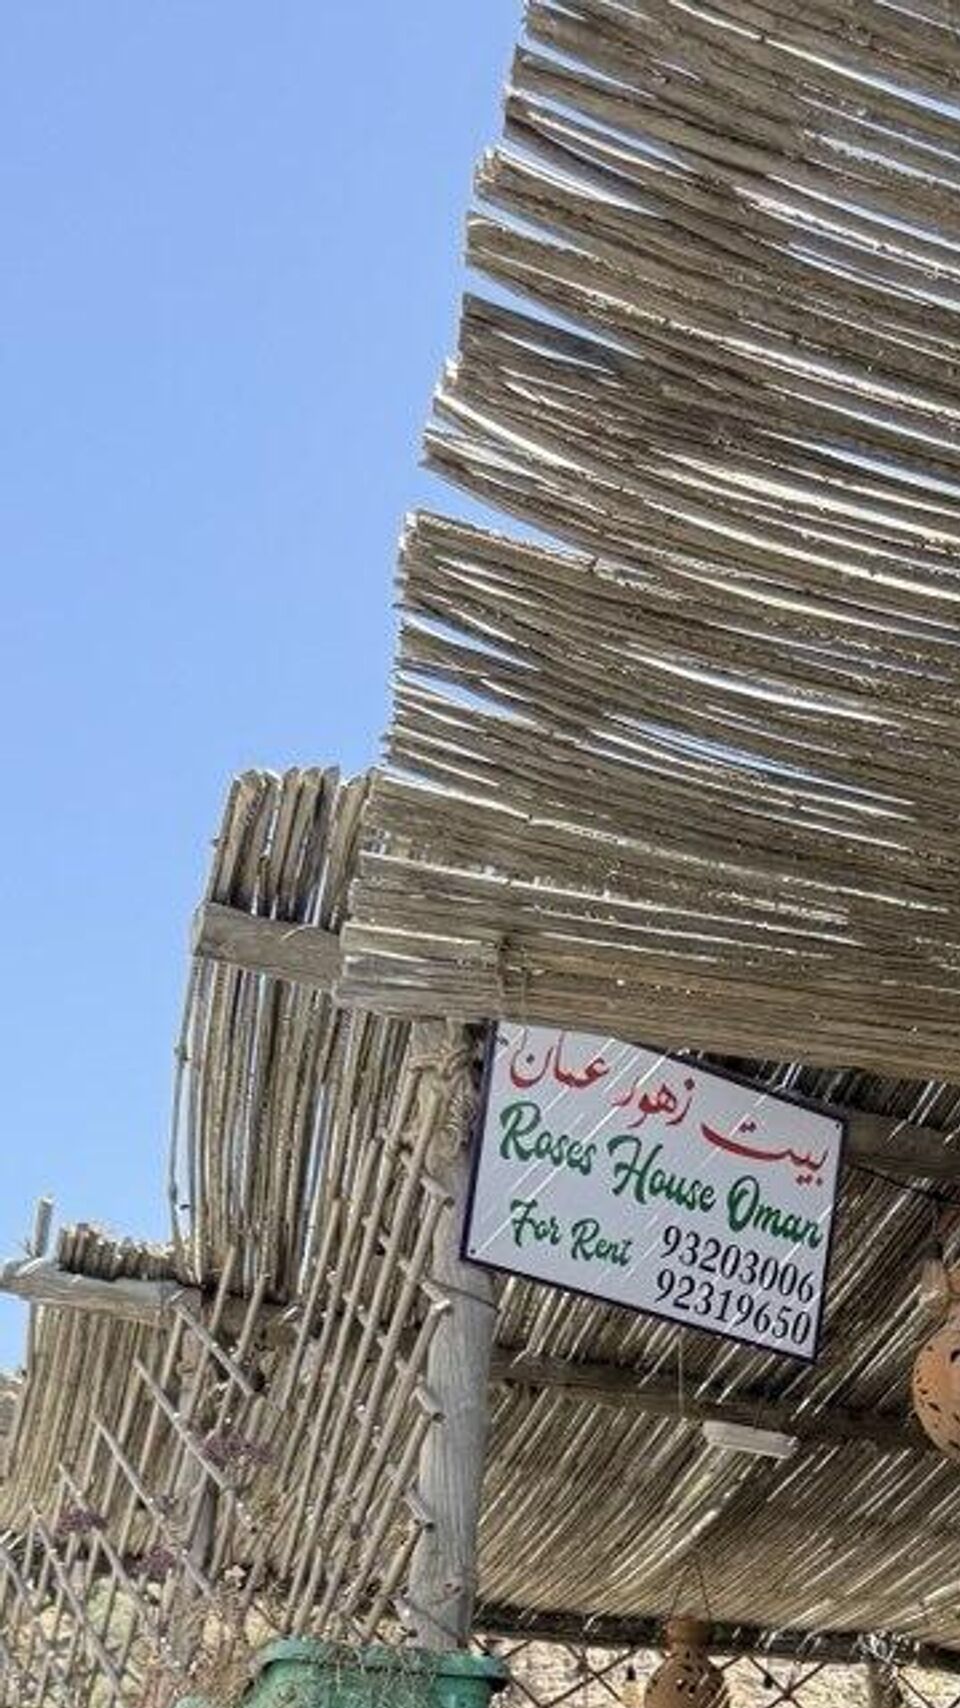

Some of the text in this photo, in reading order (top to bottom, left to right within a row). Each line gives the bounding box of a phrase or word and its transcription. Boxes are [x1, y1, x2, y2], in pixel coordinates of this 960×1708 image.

[611, 1077, 697, 1128] زهور
[499, 1101, 823, 1249] Roses House Oman
[700, 1119, 830, 1186] بيت
[509, 1198, 634, 1267] For Rent
[662, 1225, 815, 1305] 93203006
[656, 1268, 811, 1345] 92319650
